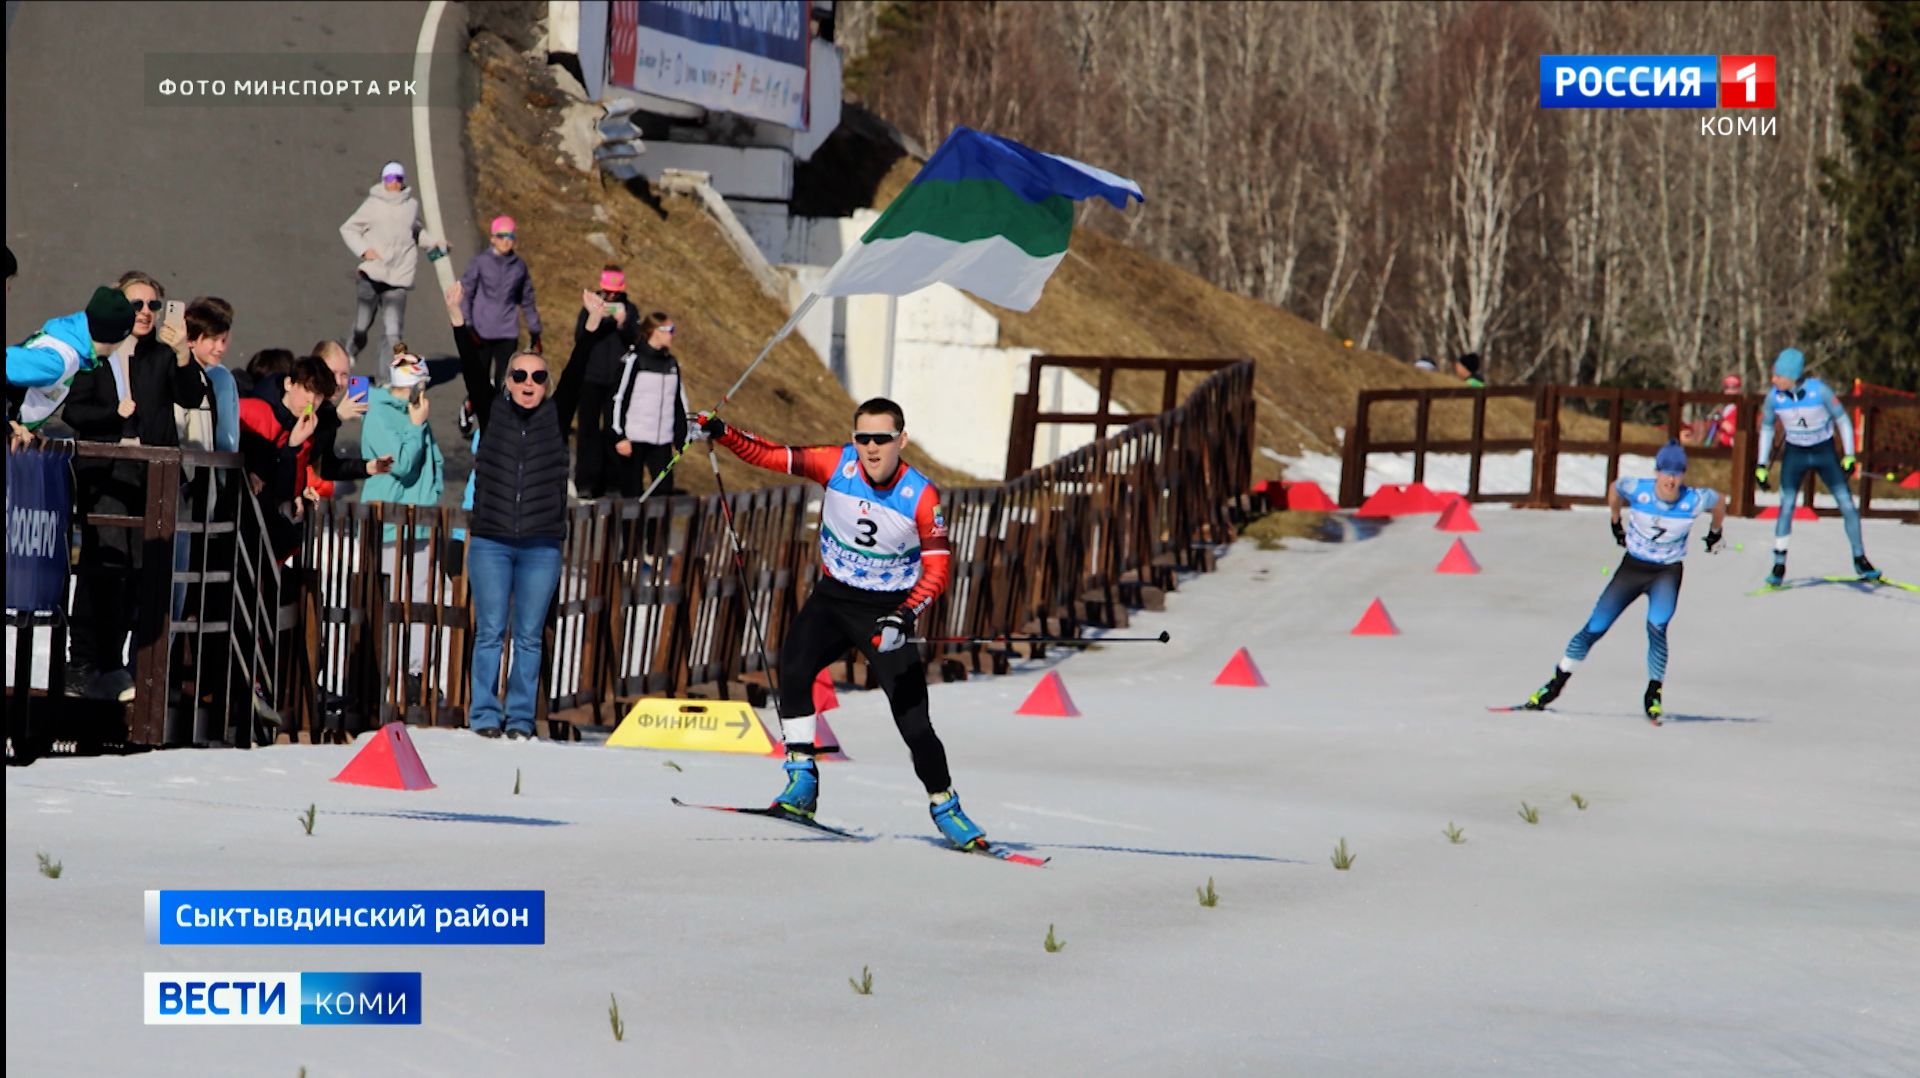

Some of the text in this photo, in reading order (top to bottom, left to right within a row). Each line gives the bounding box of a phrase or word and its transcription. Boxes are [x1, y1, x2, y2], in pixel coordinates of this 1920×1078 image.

[11, 506, 60, 559] РОСАТО
[854, 518, 878, 547] 3
[637, 713, 719, 731] ФИНИШ
